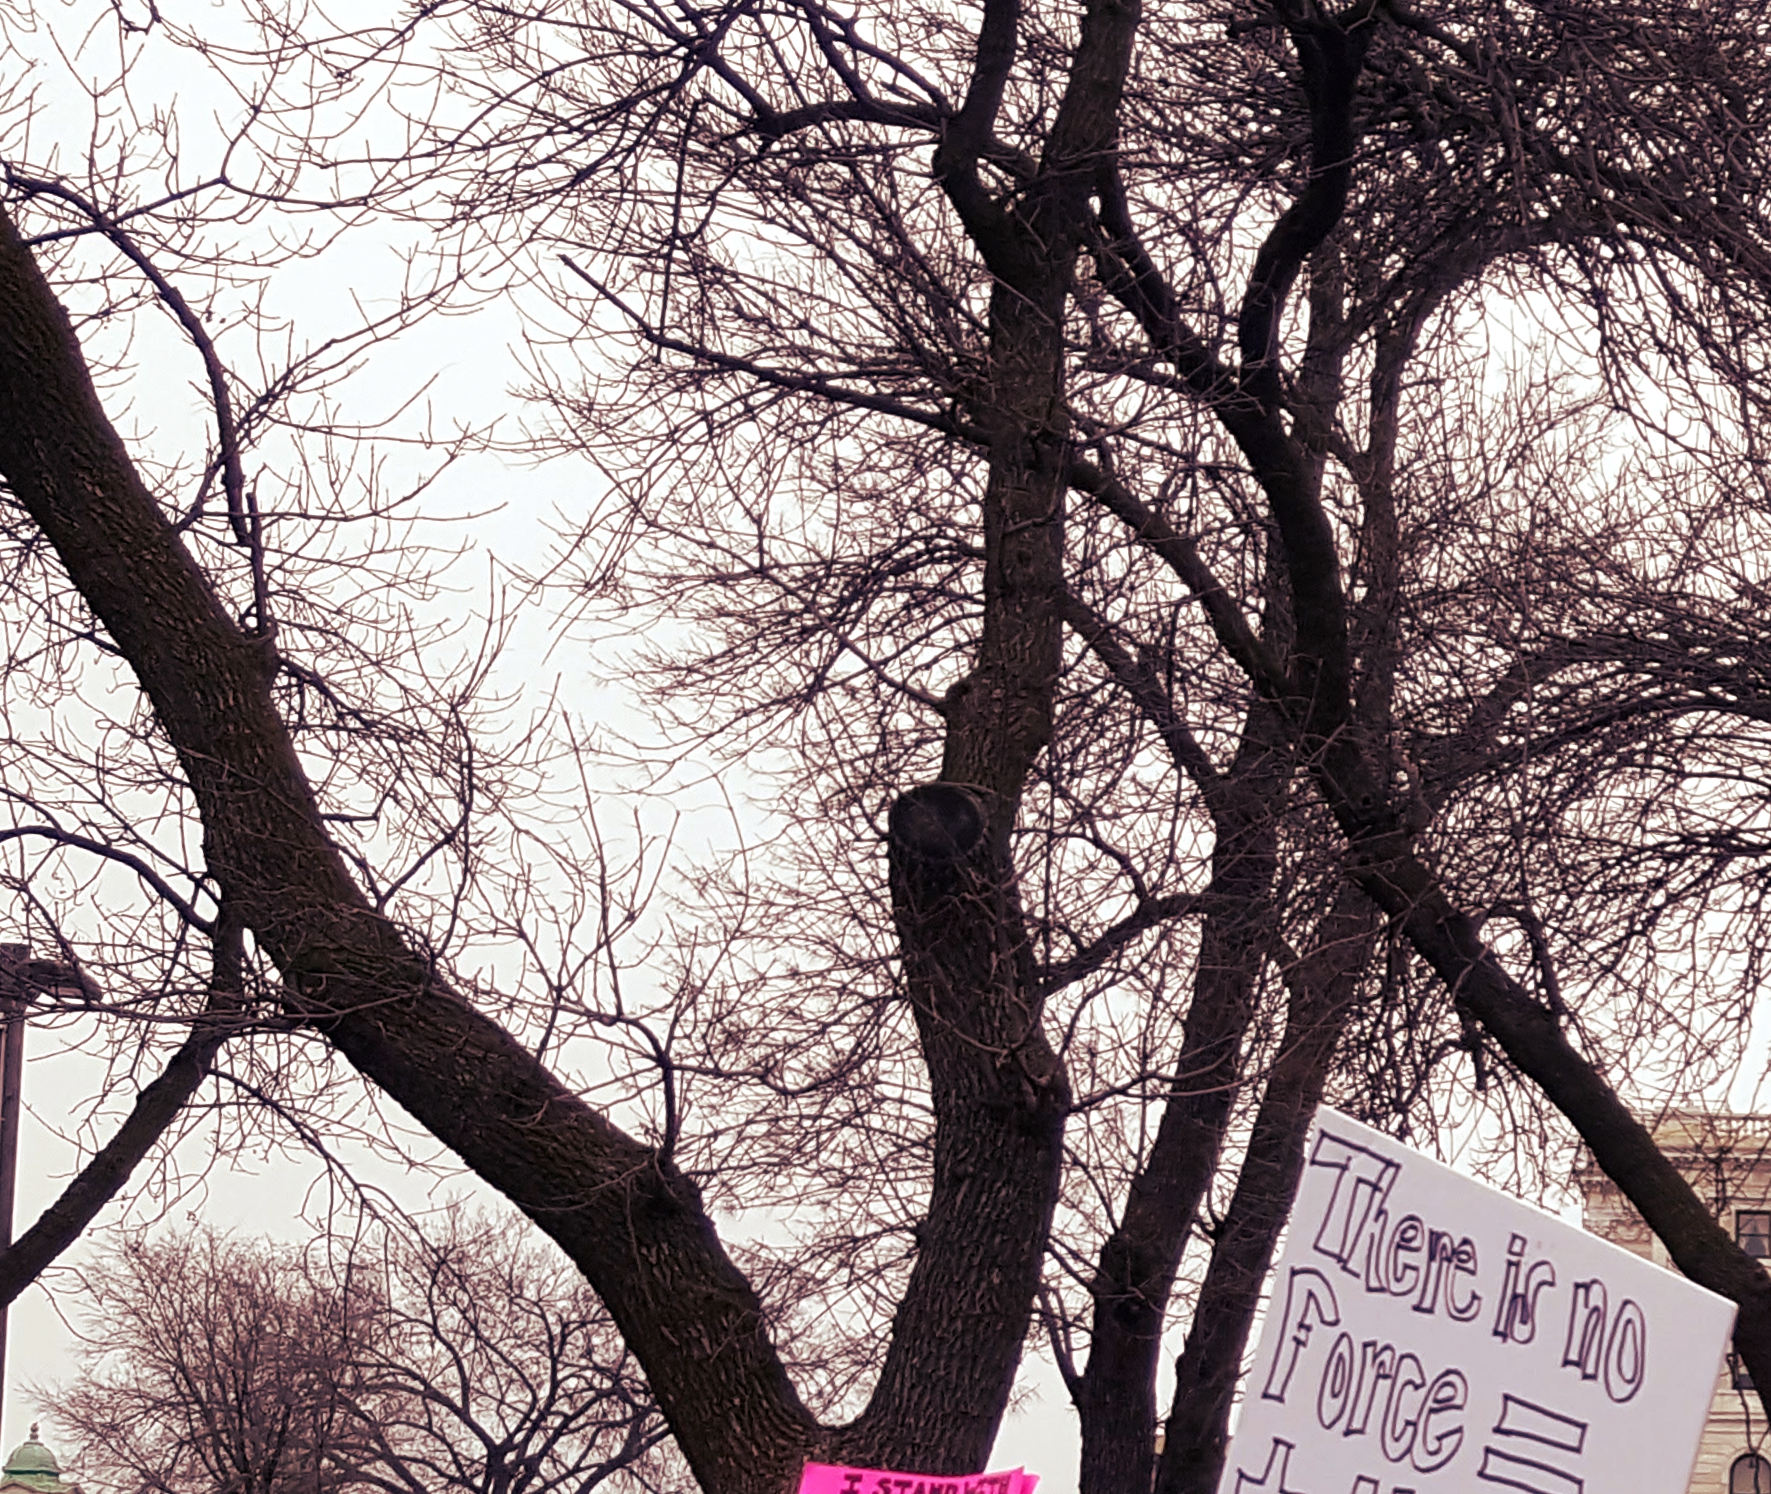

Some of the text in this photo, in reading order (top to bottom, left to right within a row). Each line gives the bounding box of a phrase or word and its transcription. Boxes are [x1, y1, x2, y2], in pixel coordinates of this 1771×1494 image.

[1262, 1266, 1468, 1474] Force
[1309, 1129, 1646, 1403] There is no
